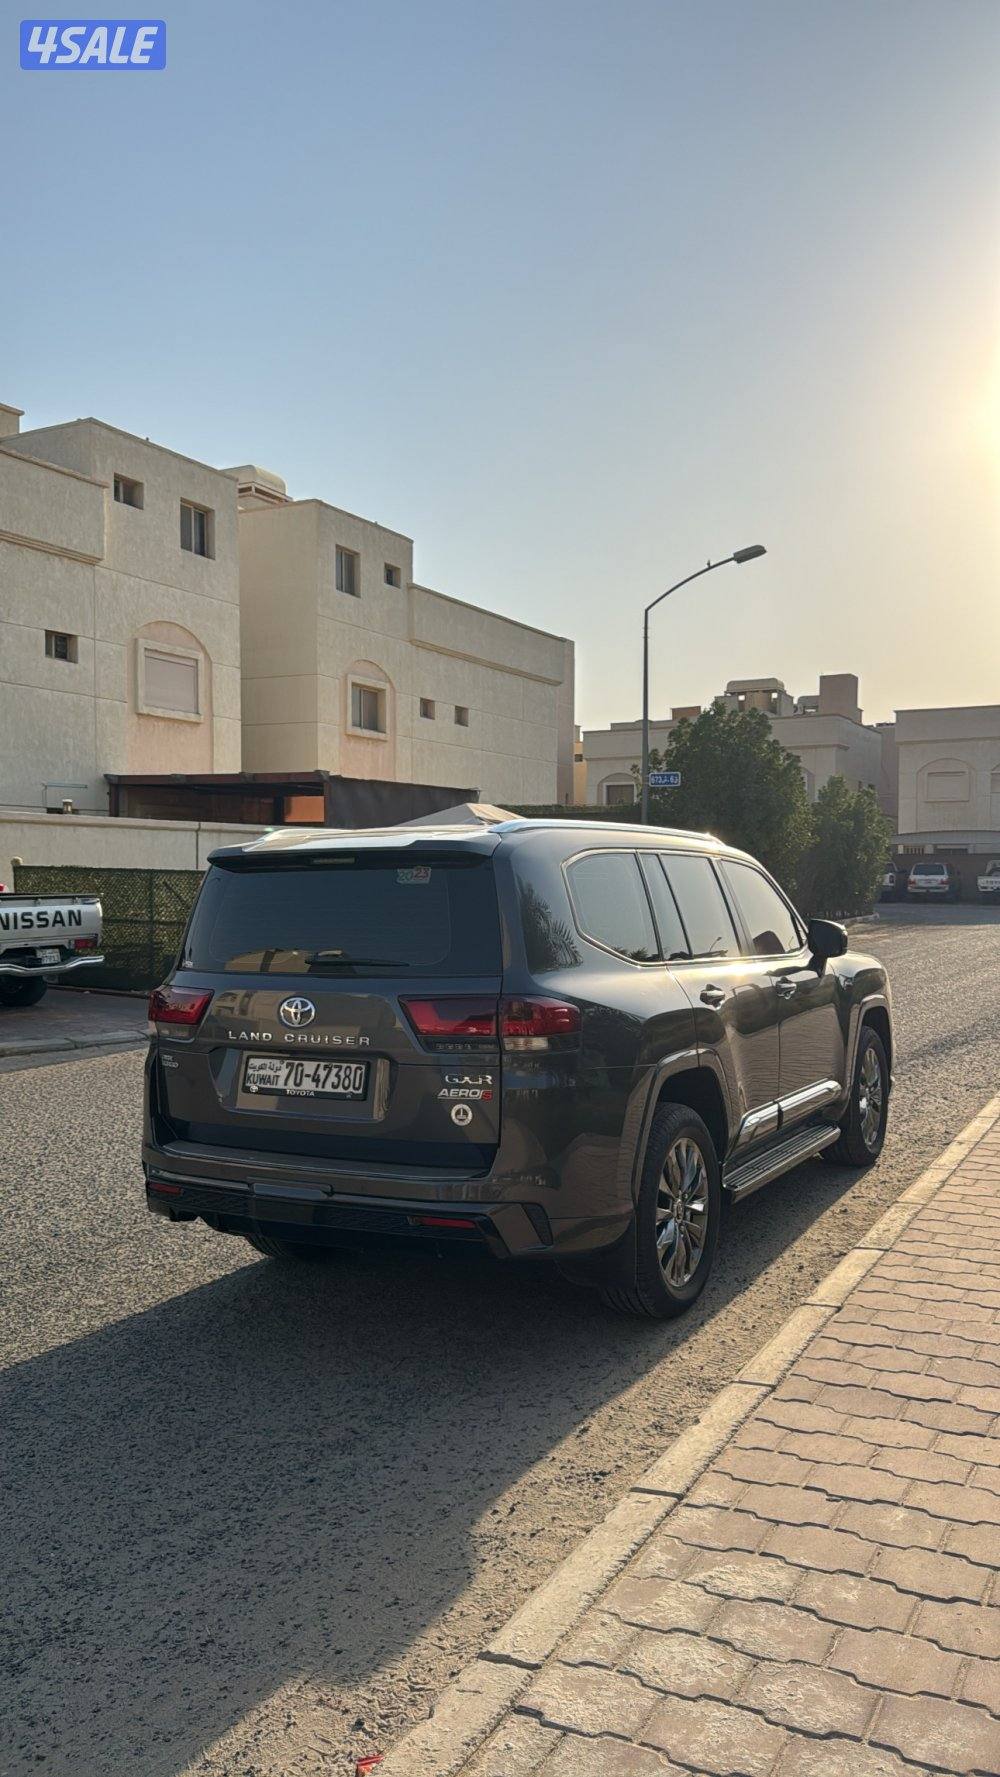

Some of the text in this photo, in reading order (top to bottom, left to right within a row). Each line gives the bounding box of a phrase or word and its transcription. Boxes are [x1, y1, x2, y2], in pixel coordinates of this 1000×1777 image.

[228, 1030, 370, 1046] LAND CRUISER
[246, 1061, 364, 1091] KUWAIT 70-47380
[286, 1089, 315, 1097] TOYOTA
